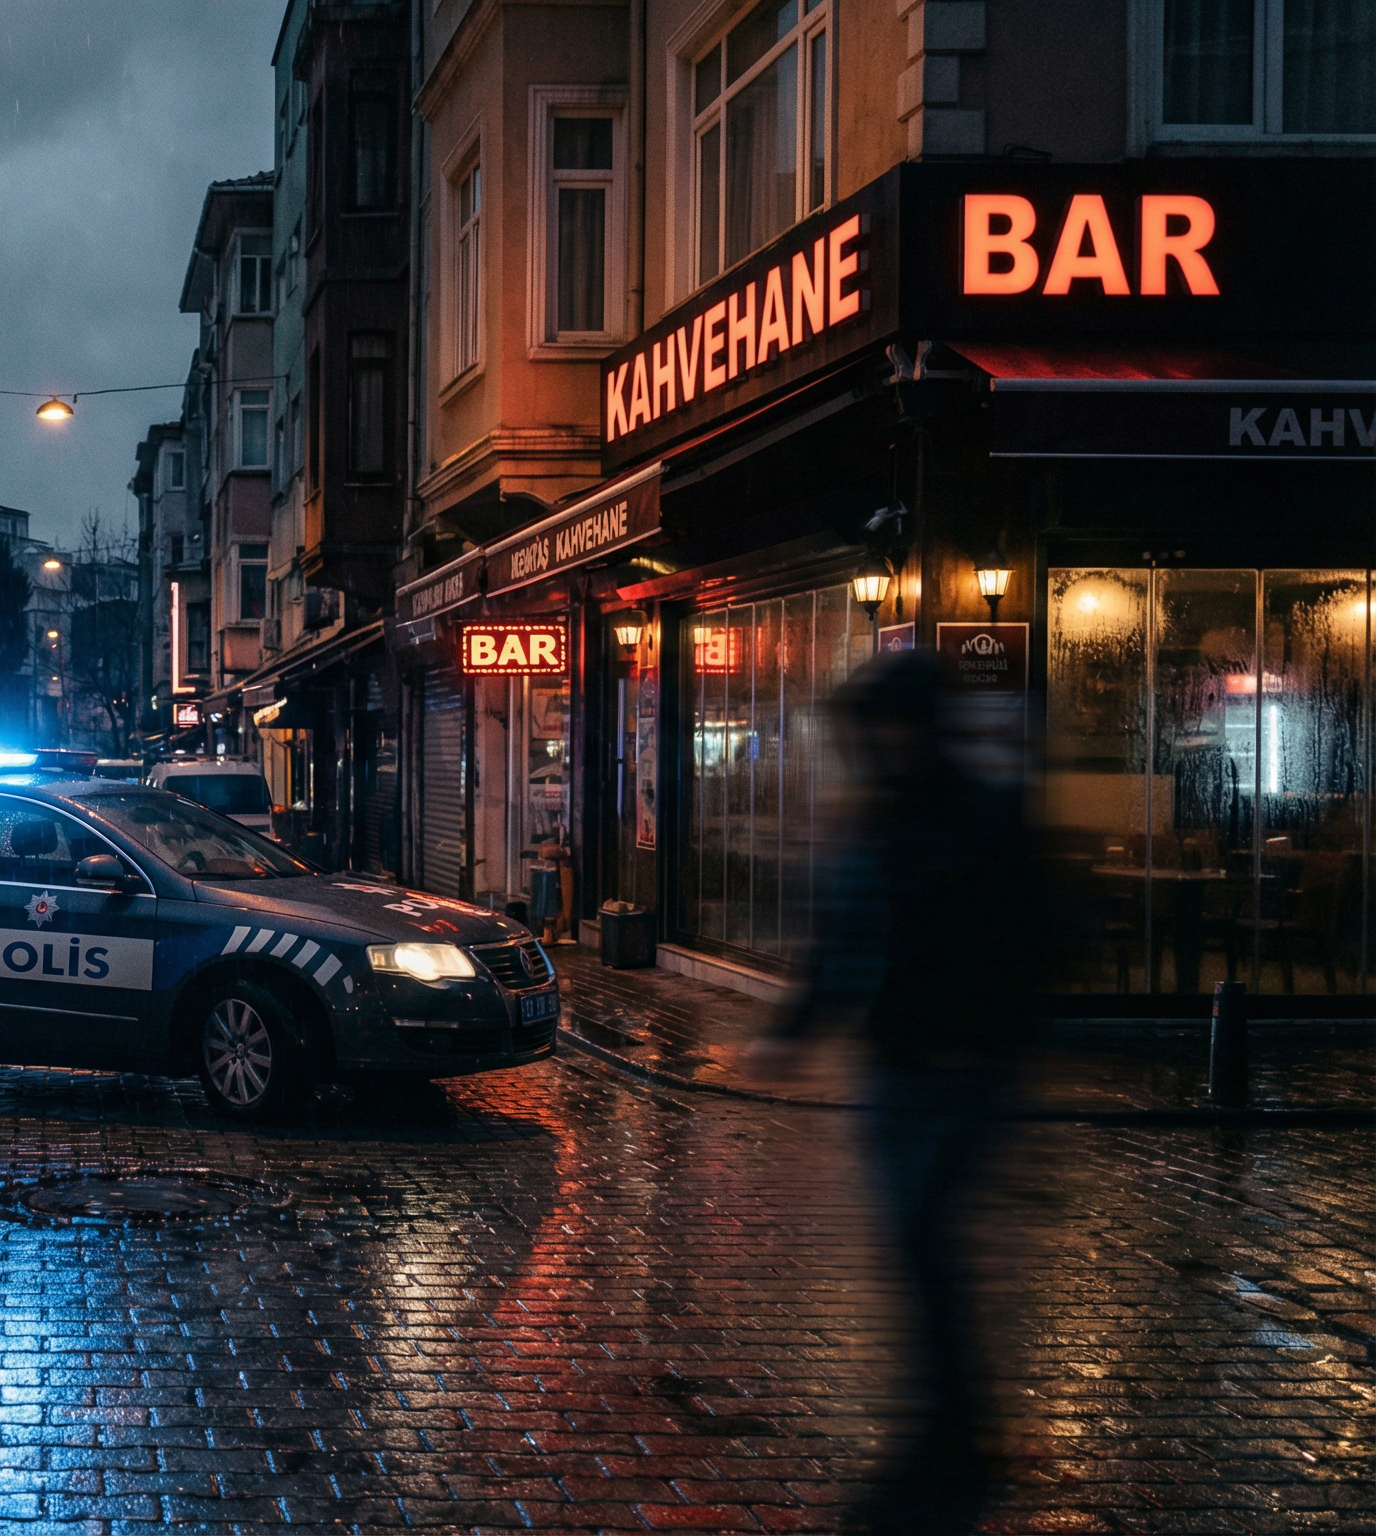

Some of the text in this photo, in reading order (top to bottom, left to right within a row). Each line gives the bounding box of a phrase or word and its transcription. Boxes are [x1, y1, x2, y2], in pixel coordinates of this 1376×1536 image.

[962, 194, 1220, 296] BAR
[606, 214, 860, 442] KAHVEHANE
[556, 500, 627, 562] KAHVEHANE
[470, 635, 558, 666] BAR
